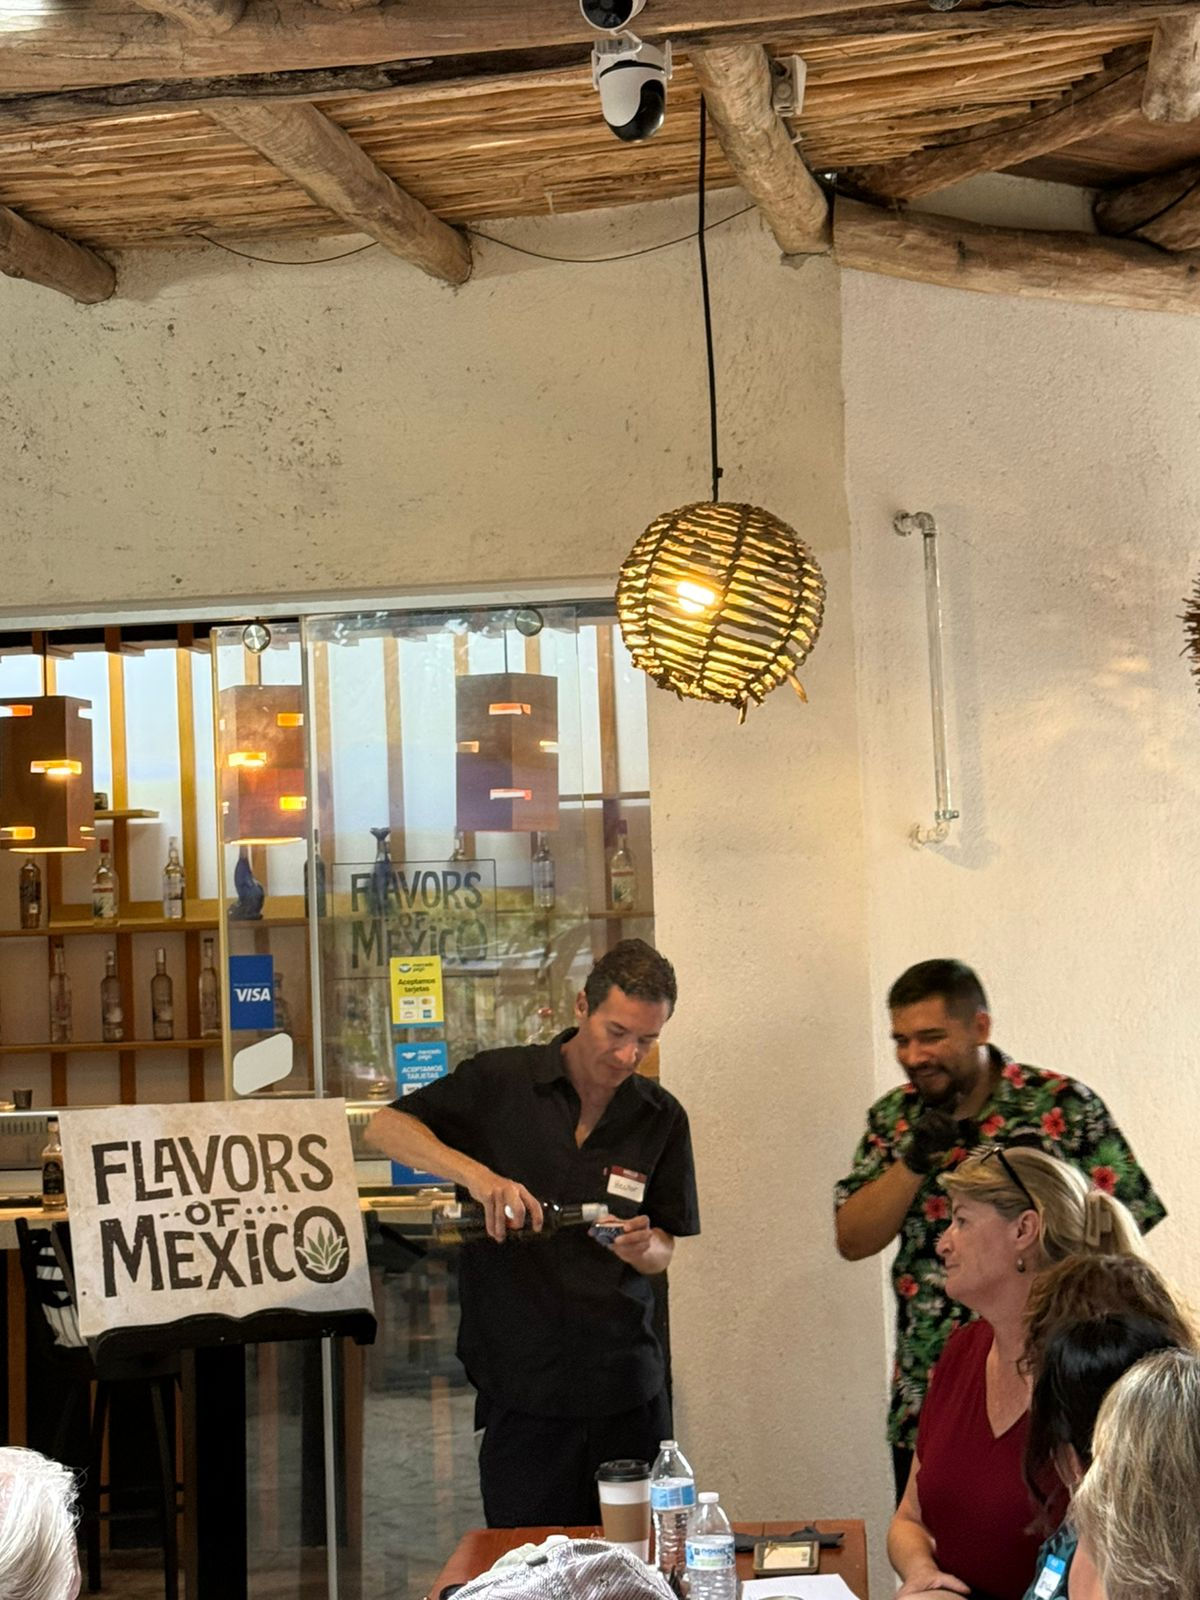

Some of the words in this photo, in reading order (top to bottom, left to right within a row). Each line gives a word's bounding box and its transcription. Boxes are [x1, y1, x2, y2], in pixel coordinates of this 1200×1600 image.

[401, 910, 429, 929] OF
[233, 987, 271, 1002] VISA
[404, 986, 430, 994] tarjetas
[401, 1064, 443, 1073] ACEPTAMOS
[91, 1133, 334, 1205] FLAVORS
[185, 1197, 241, 1227] OF
